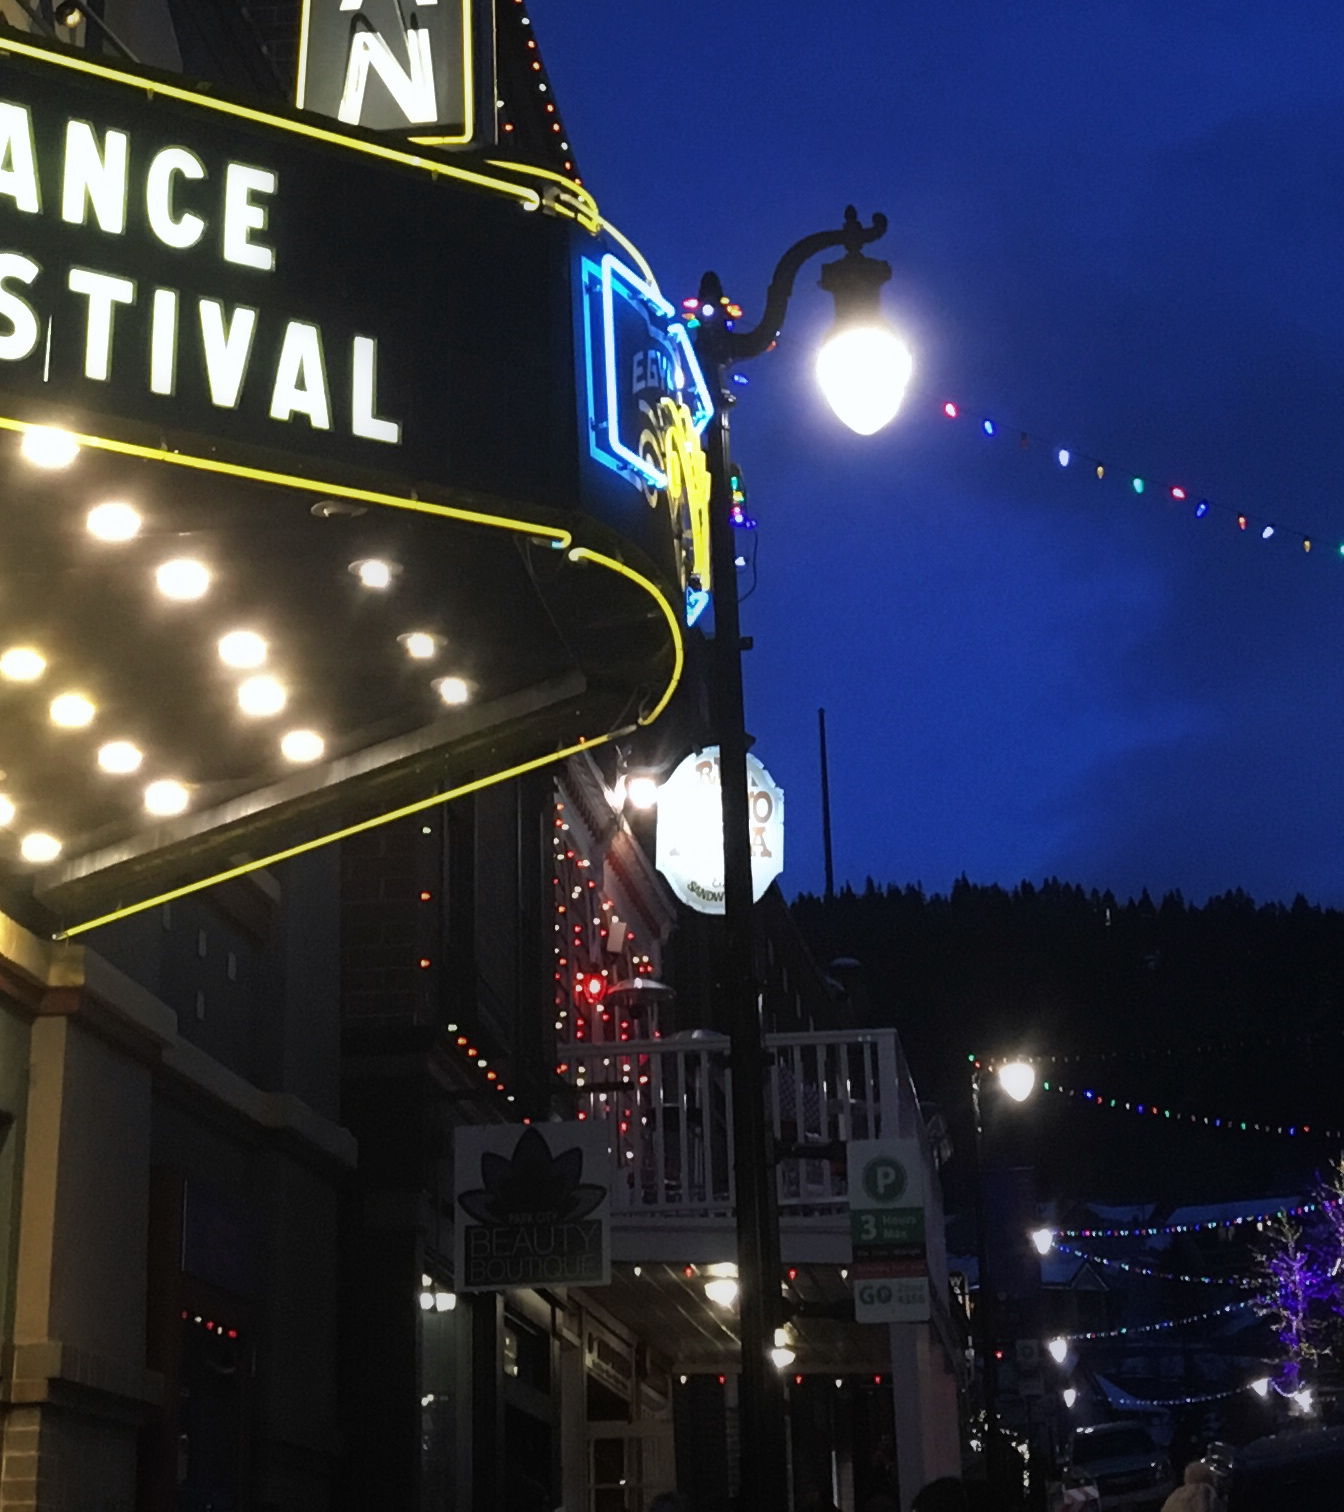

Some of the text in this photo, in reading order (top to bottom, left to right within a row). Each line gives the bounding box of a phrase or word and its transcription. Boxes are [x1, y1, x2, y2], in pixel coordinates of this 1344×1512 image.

[876, 1165, 897, 1195] P
[508, 1211, 559, 1225] PARK CITY
[860, 1214, 878, 1241] 3
[469, 1223, 598, 1258] BEAUTY
[469, 1253, 598, 1282] BOUTIQUE
